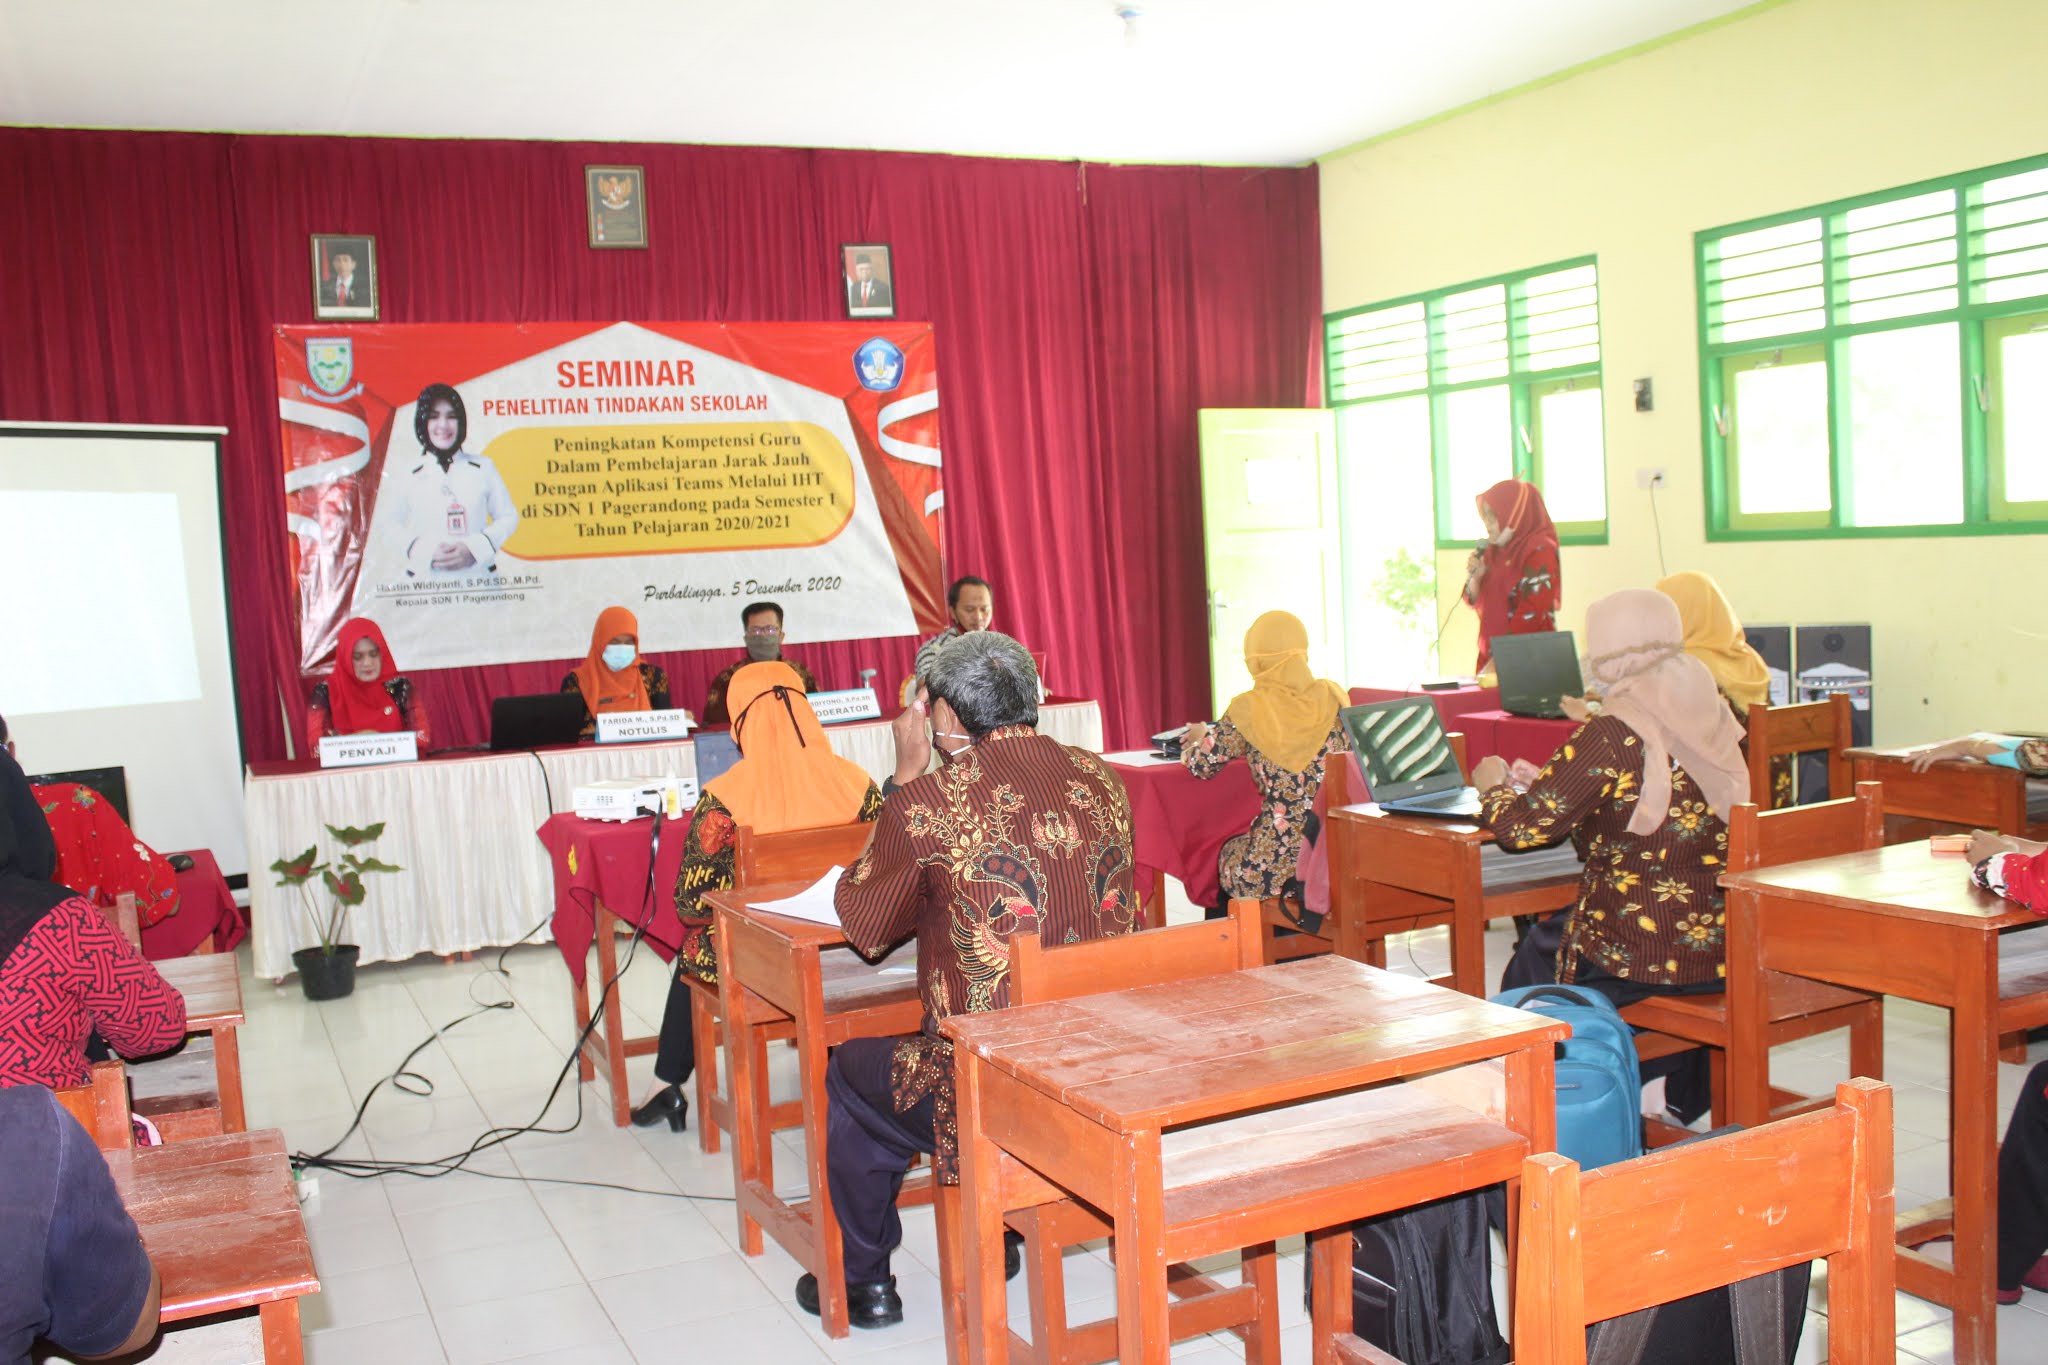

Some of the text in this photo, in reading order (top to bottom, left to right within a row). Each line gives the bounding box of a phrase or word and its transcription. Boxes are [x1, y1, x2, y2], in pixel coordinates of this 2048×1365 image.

[557, 359, 696, 389] SEMINAR
[483, 394, 768, 417] PENELITIAN TINDAKAN SEKOLAH
[554, 432, 802, 454] Peningkatan Kompetensi Guru
[546, 452, 810, 474] Dalam Pembelajaran Jarak Jauh
[534, 471, 824, 498] Dengan Aplikasi Teams Melalui IHT
[521, 492, 837, 519] di SDN 1 Pagerandong pada Semester 1
[574, 514, 791, 538] Tahun Pelajaran 2020/2021
[413, 579, 464, 592] Widiyanti,
[731, 581, 741, 596] 5
[744, 578, 802, 596] Desember
[807, 576, 842, 591] 2020
[395, 592, 525, 608] Kepala SDN 1 Pagerandong
[602, 717, 633, 726] FARIDA
[815, 704, 870, 718] ODERATOR
[619, 726, 668, 737] NOTULIS
[339, 746, 397, 759] PENYAJI
